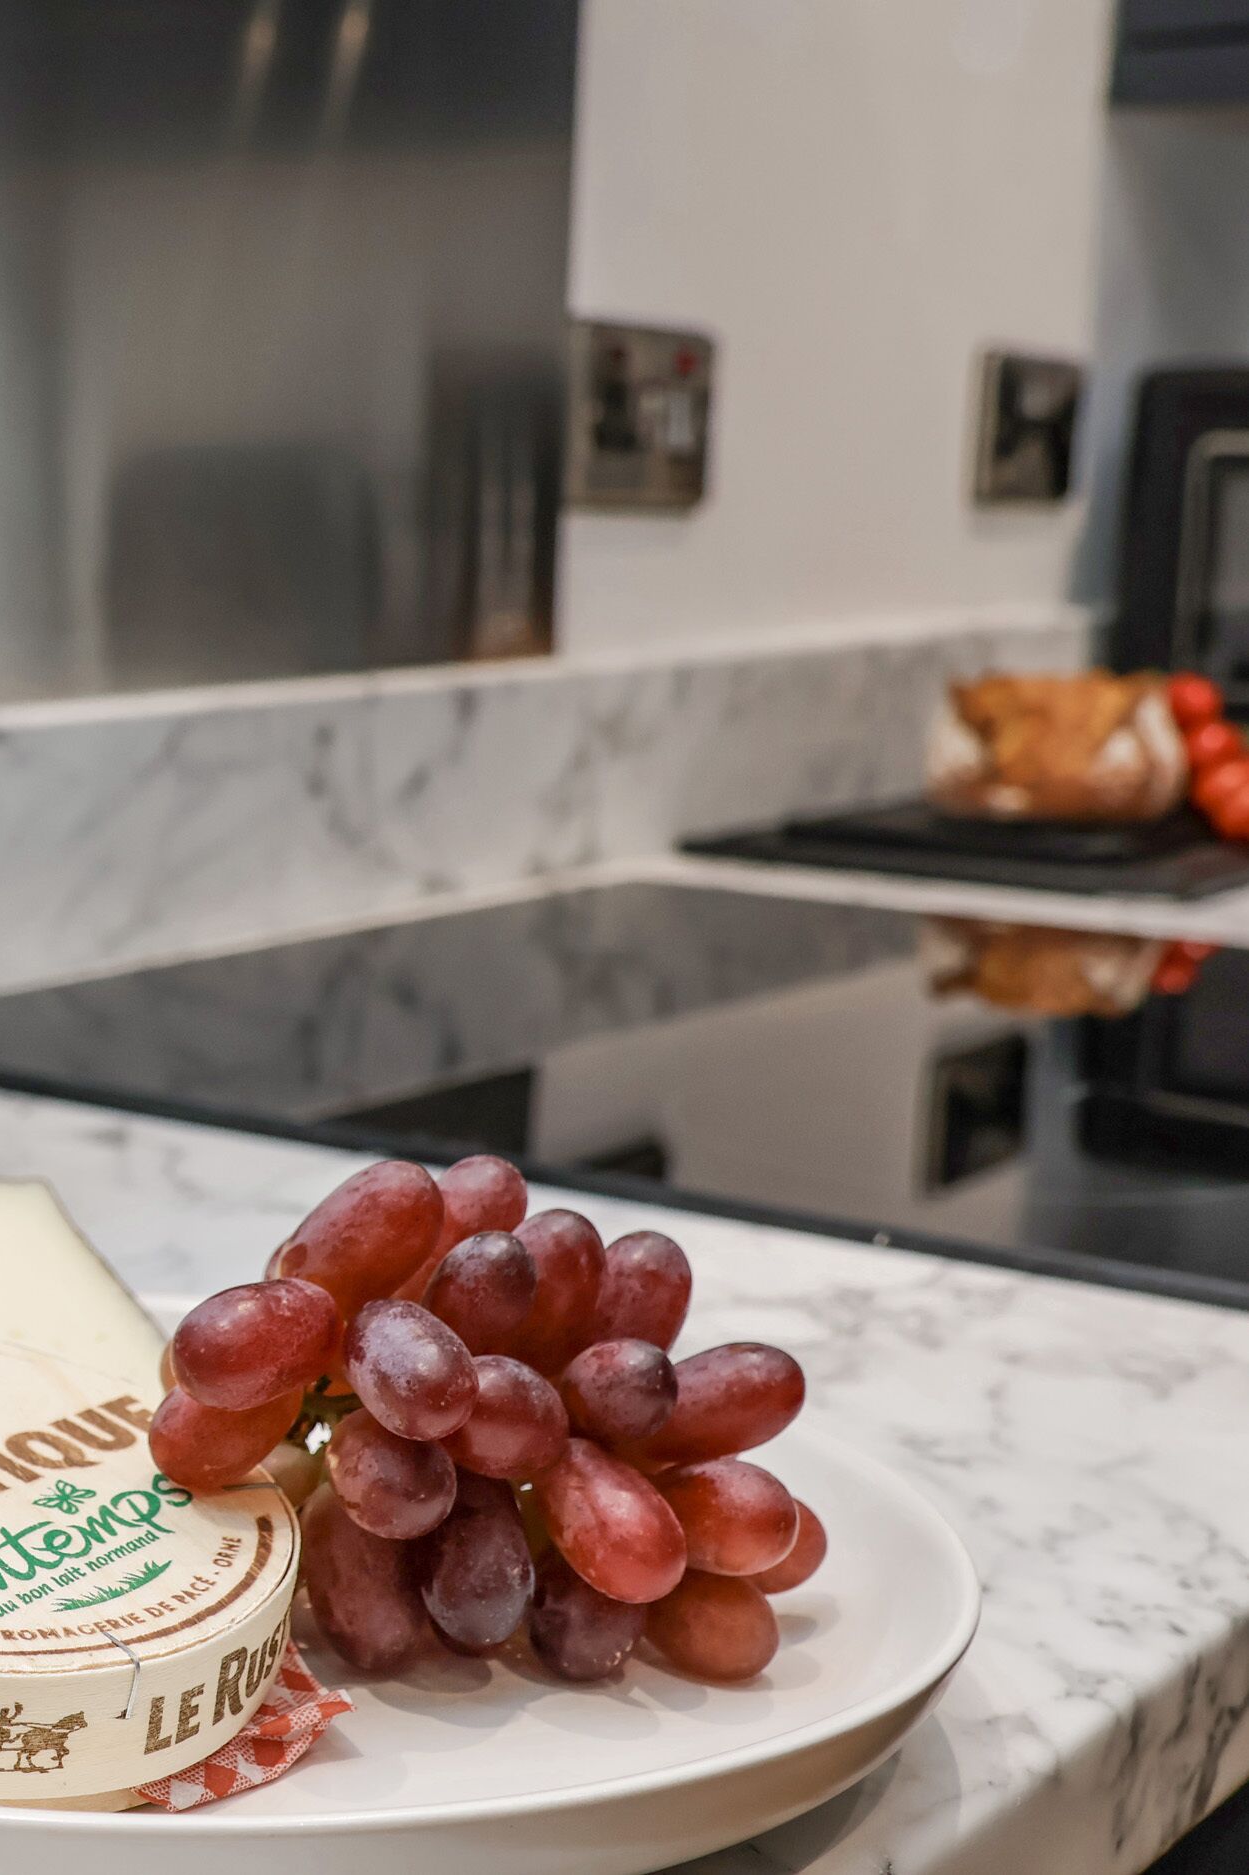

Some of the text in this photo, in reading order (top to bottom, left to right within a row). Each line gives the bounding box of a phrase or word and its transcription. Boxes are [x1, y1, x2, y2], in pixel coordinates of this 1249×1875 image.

[15, 1582, 55, 1605] bon
[51, 1566, 88, 1588] lait
[85, 1530, 161, 1572] normand
[143, 1601, 177, 1618] DE
[212, 1536, 242, 1568] ORNE
[143, 1682, 207, 1756] LE
